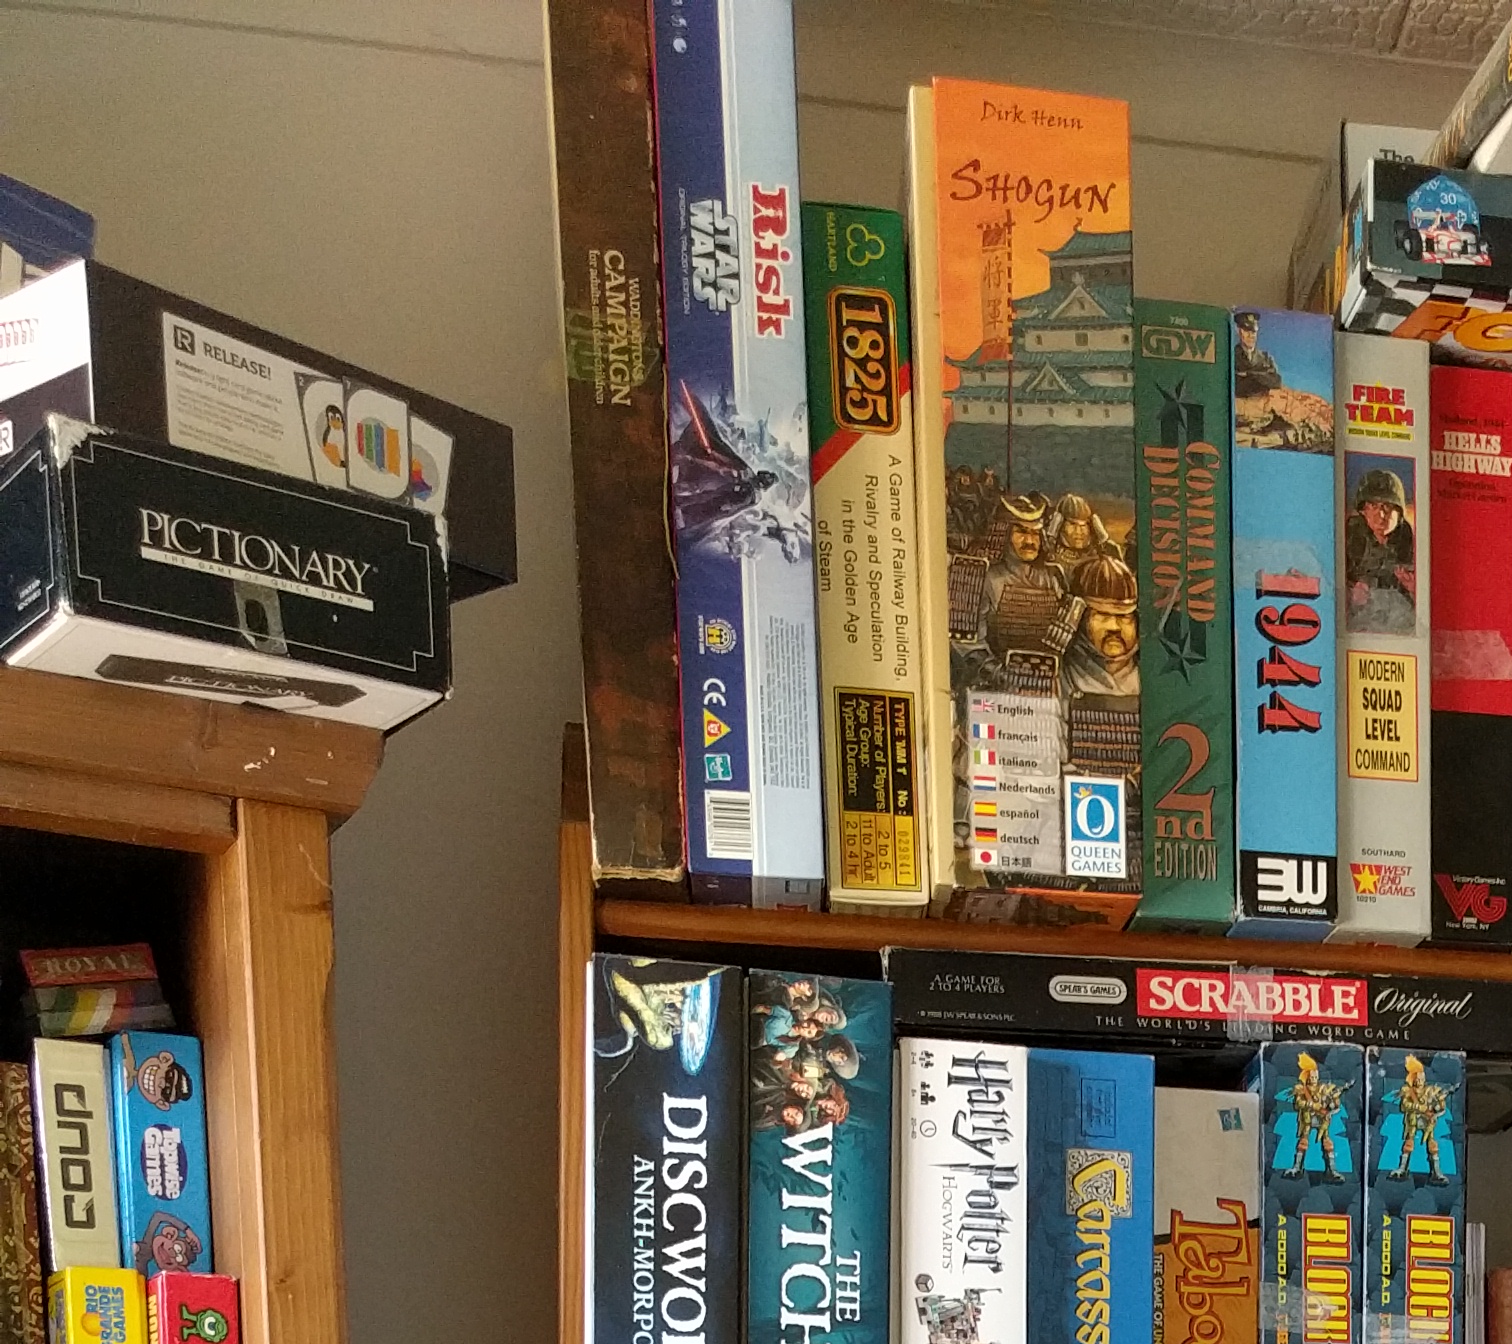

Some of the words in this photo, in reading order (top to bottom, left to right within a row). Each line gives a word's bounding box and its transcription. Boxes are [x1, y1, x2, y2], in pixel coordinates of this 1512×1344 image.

[981, 101, 1025, 125] Dirk
[1031, 112, 1084, 130] Henn
[604, 251, 631, 406] CAMPAIGN
[202, 341, 272, 380] RELEASE!
[841, 300, 887, 424] 1825
[1352, 384, 1406, 407] FIRE
[1345, 403, 1414, 428] TEAM
[888, 454, 900, 464] A
[890, 470, 903, 520] Game
[891, 528, 903, 546] of
[141, 508, 371, 596] PICTIONARY
[891, 549, 906, 612] Railway
[1256, 569, 1321, 734] 1944
[1359, 660, 1406, 683] MODERN
[997, 705, 1034, 717] English
[1362, 687, 1403, 712] SQUAD
[1364, 717, 1401, 742] LEVEL
[997, 758, 1038, 769] italiano
[1355, 749, 1412, 773] COMMAND
[1000, 783, 1055, 795] Nederlands
[1000, 834, 1039, 845] deutsch
[1071, 845, 1121, 861] QUEEN
[1071, 860, 1122, 875] GAMES
[1149, 976, 1359, 1019] SCRABBLE
[1374, 987, 1473, 1021] Original
[947, 1050, 1014, 1159] Harry
[55, 1083, 96, 1230] COUP
[928, 1163, 1021, 1275] Potter
[836, 1251, 860, 1322] THE
